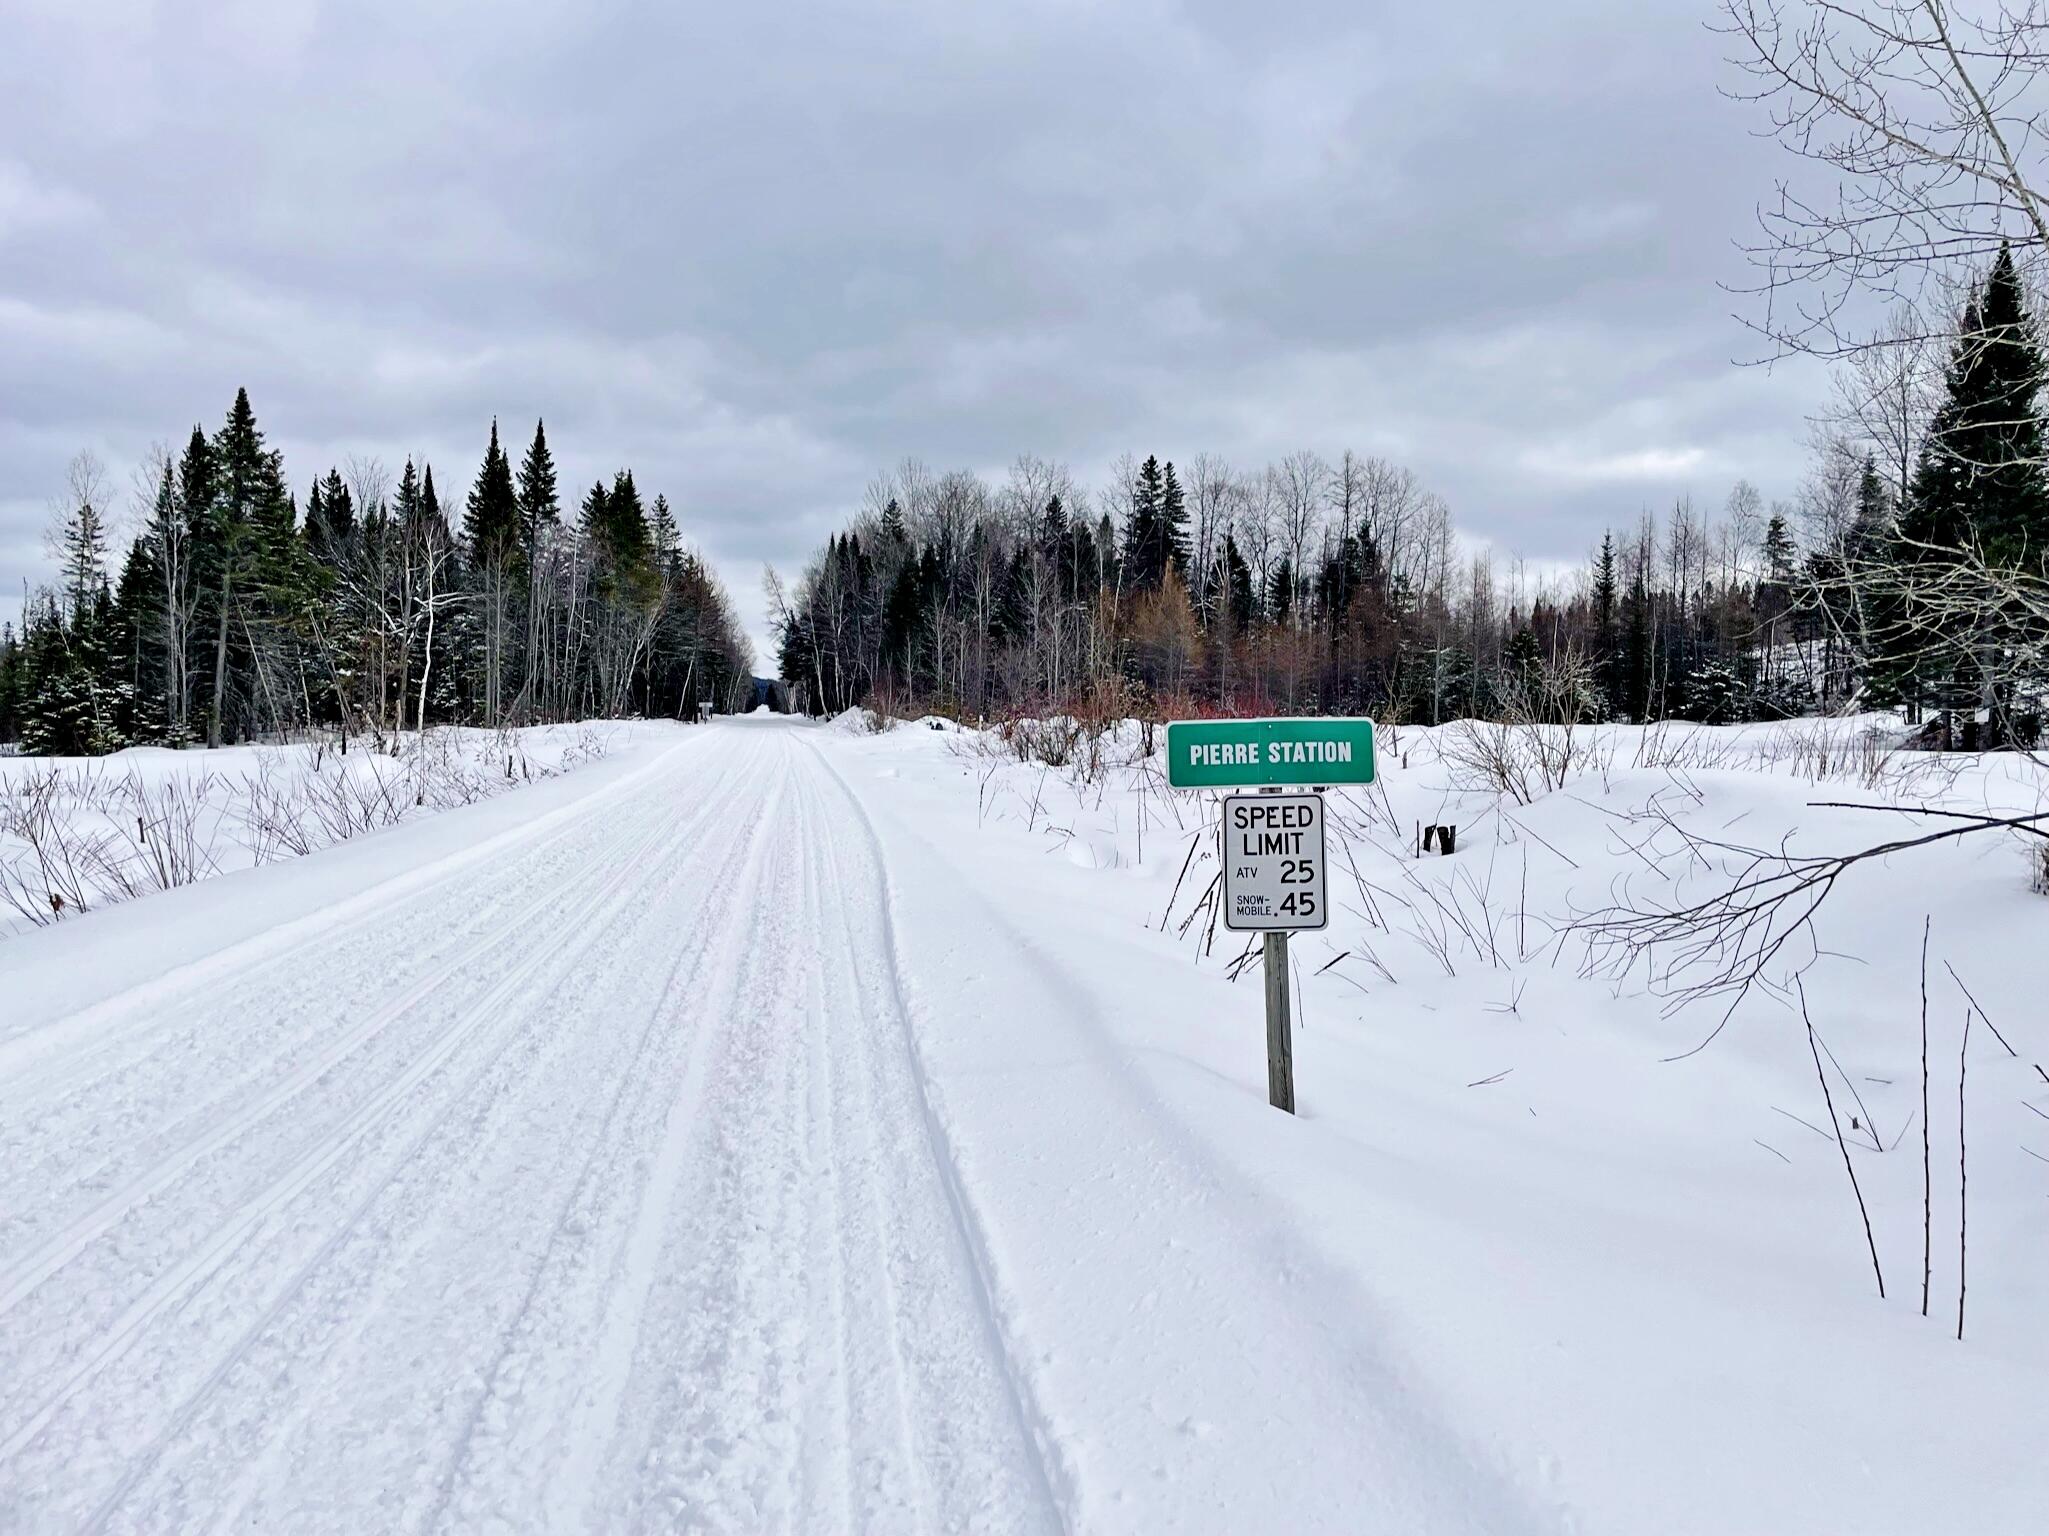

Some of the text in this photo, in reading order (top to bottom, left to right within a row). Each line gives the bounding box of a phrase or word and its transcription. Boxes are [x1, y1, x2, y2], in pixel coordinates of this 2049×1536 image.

[1190, 741, 1352, 766] PIERRE STATION
[1234, 805, 1314, 829] SPEED
[1243, 832, 1304, 856] LIMIT
[1236, 859, 1315, 884] ATV 25
[1236, 895, 1270, 905] SNOW-
[1236, 906, 1272, 916] MOBILE
[1279, 892, 1316, 917] 45
